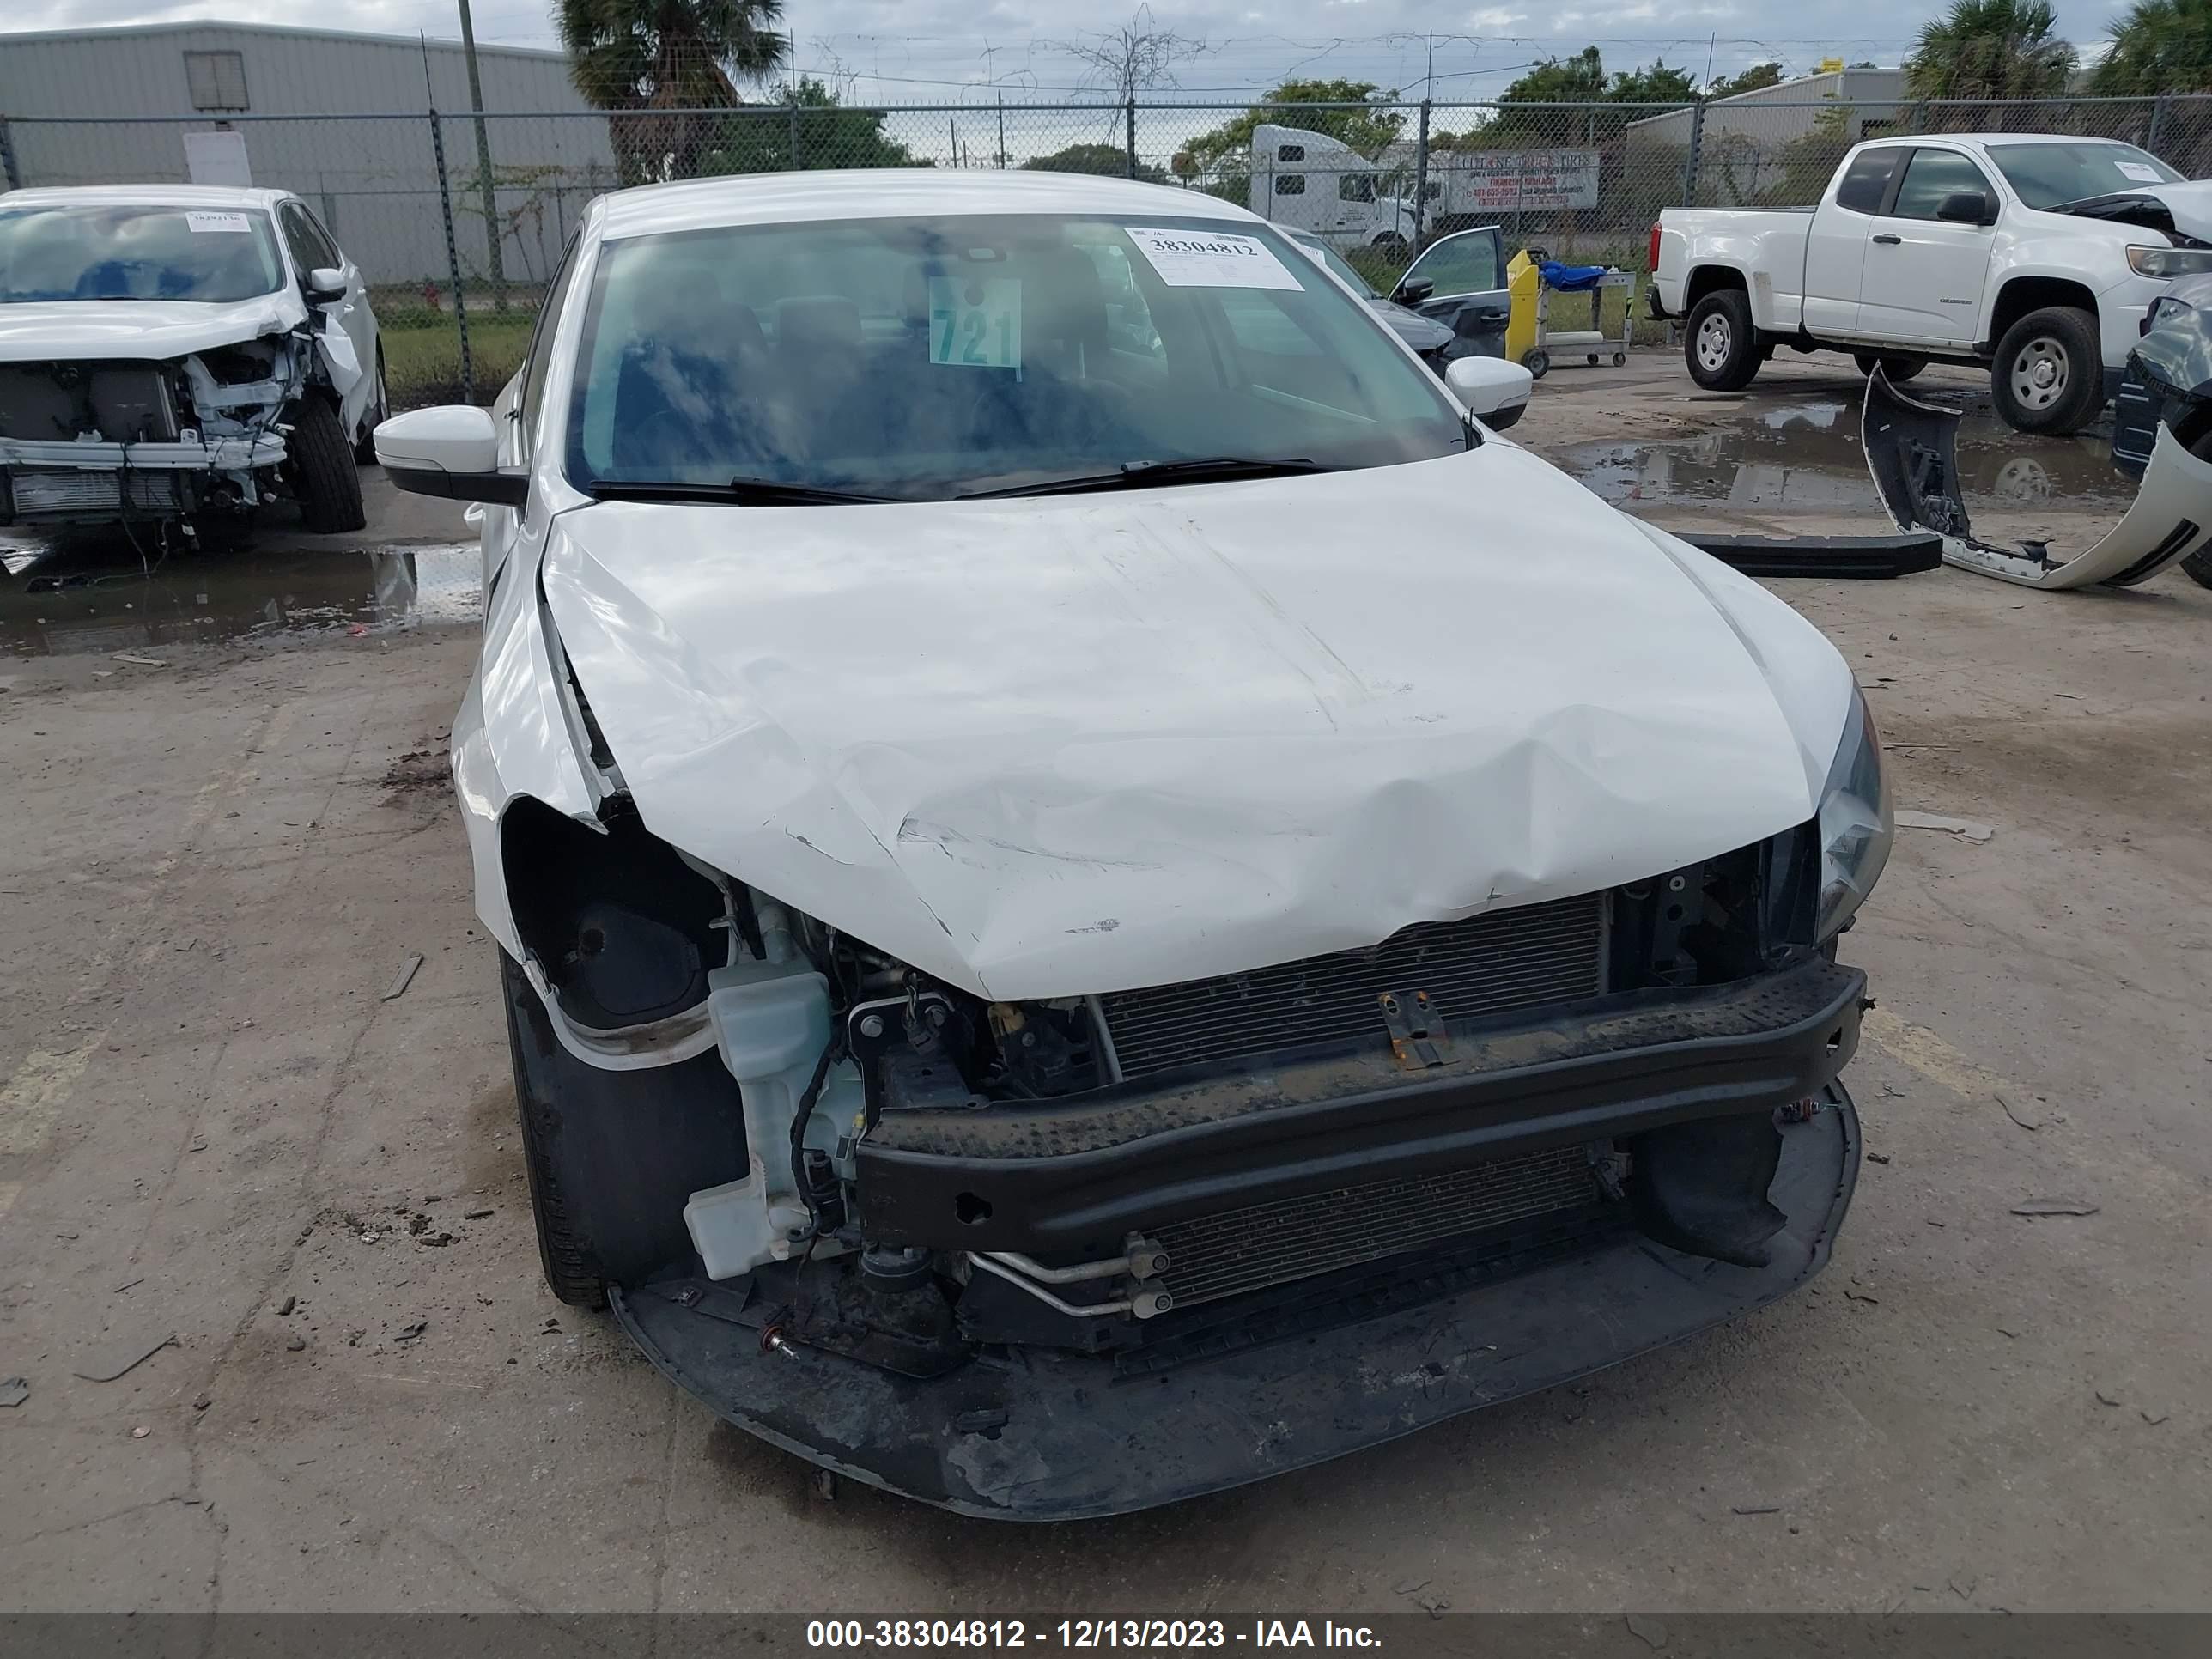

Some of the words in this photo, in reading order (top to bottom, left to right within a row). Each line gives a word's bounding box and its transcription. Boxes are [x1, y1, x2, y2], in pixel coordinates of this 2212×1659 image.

[1560, 153, 1591, 167] TIRES
[1150, 240, 1258, 256] 38304812
[933, 310, 1011, 365] 721
